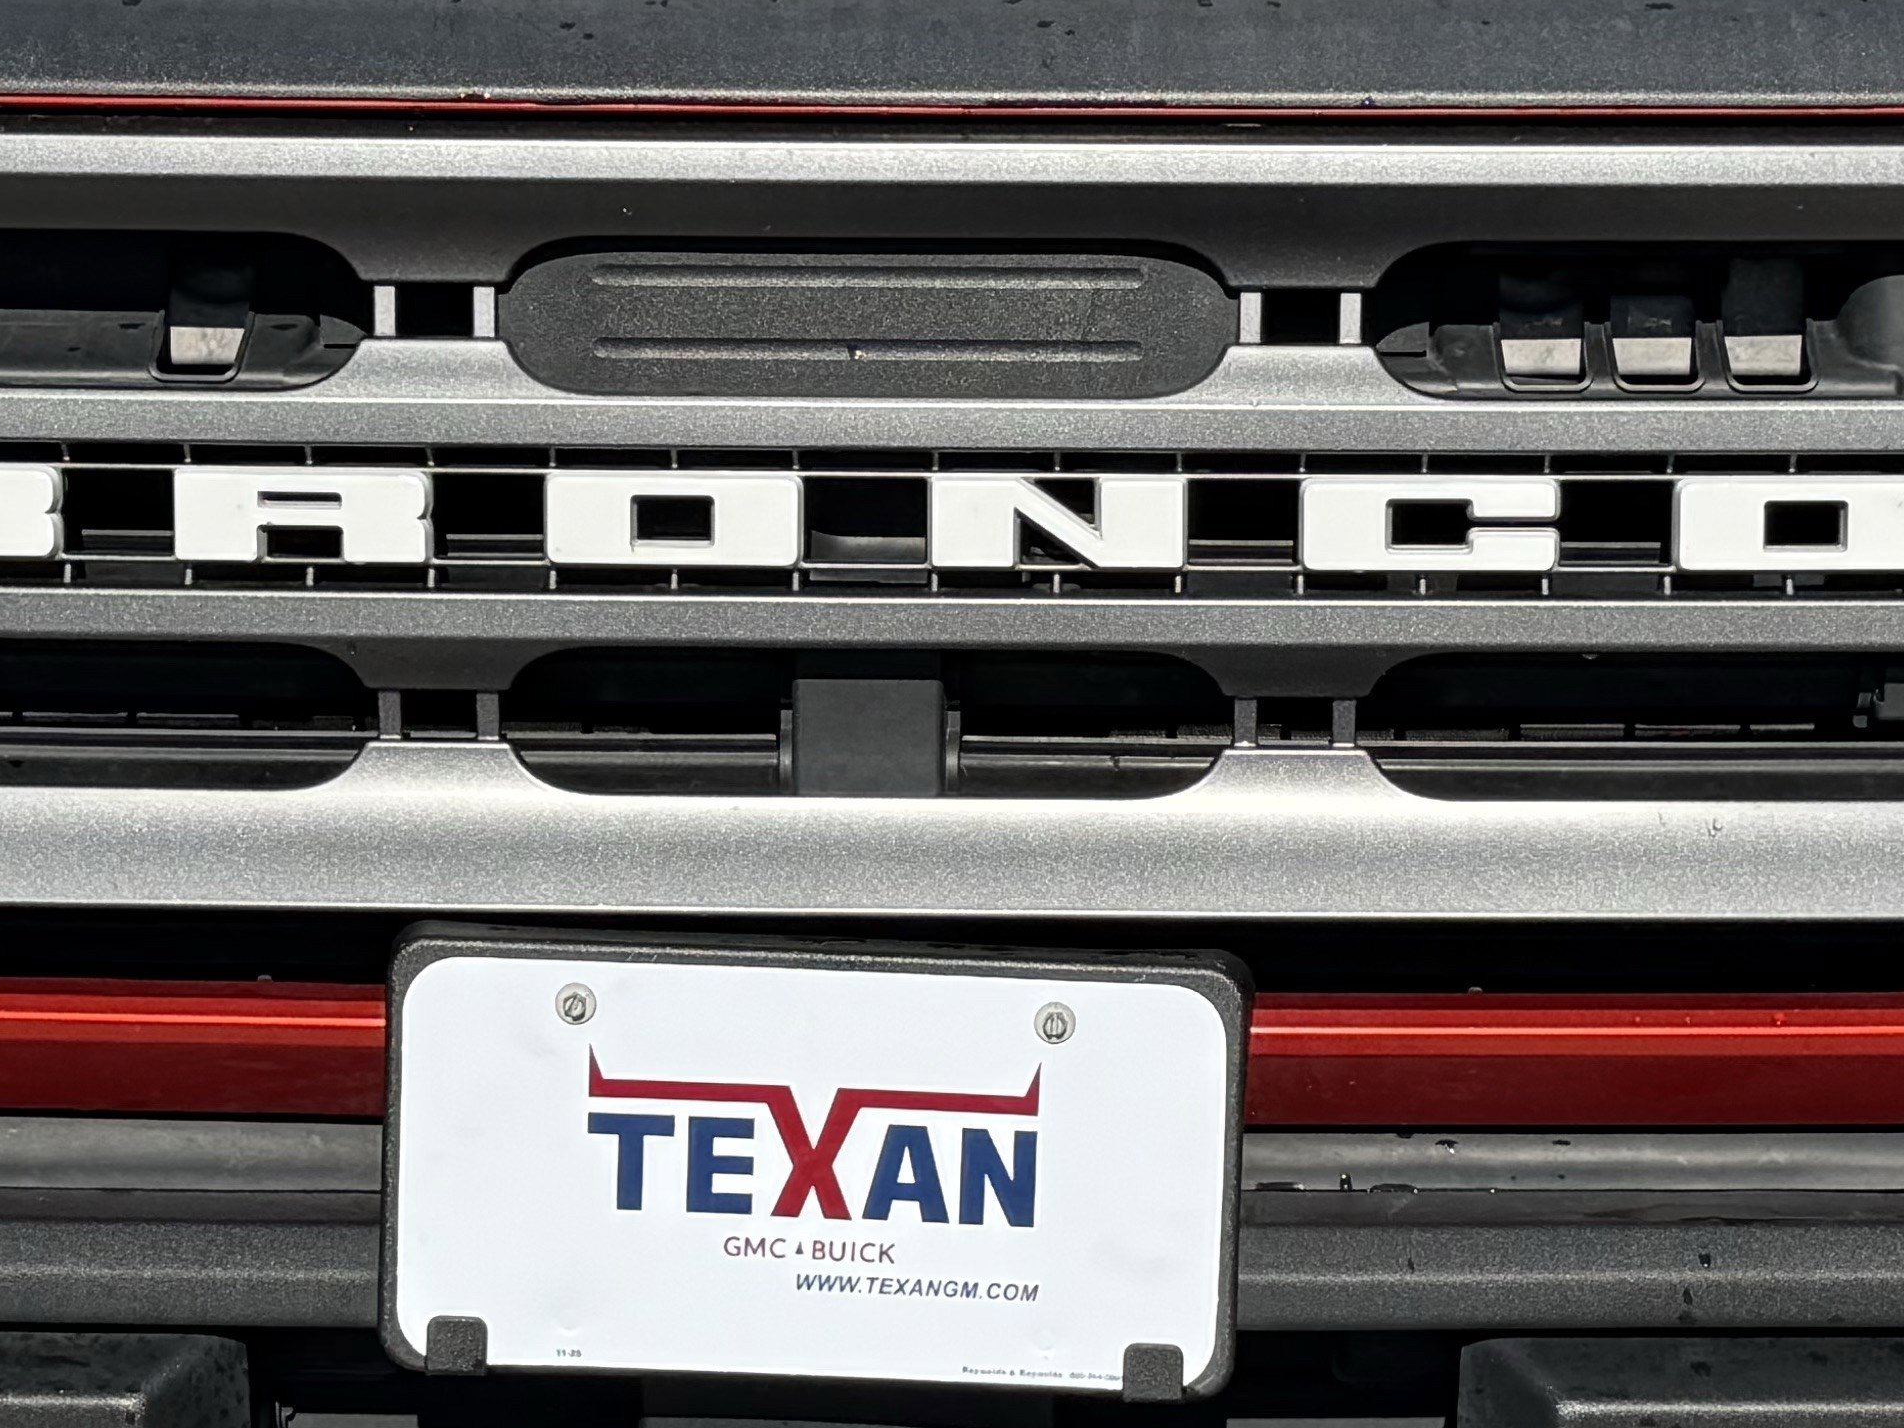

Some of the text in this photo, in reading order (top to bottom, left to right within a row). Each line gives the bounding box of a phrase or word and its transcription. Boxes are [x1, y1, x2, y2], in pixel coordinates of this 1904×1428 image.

[588, 1044, 1042, 1228] TEXAN
[723, 1235, 896, 1264] GMC BUICK
[795, 1274, 1040, 1302] WWW.TEXANGM.COM
